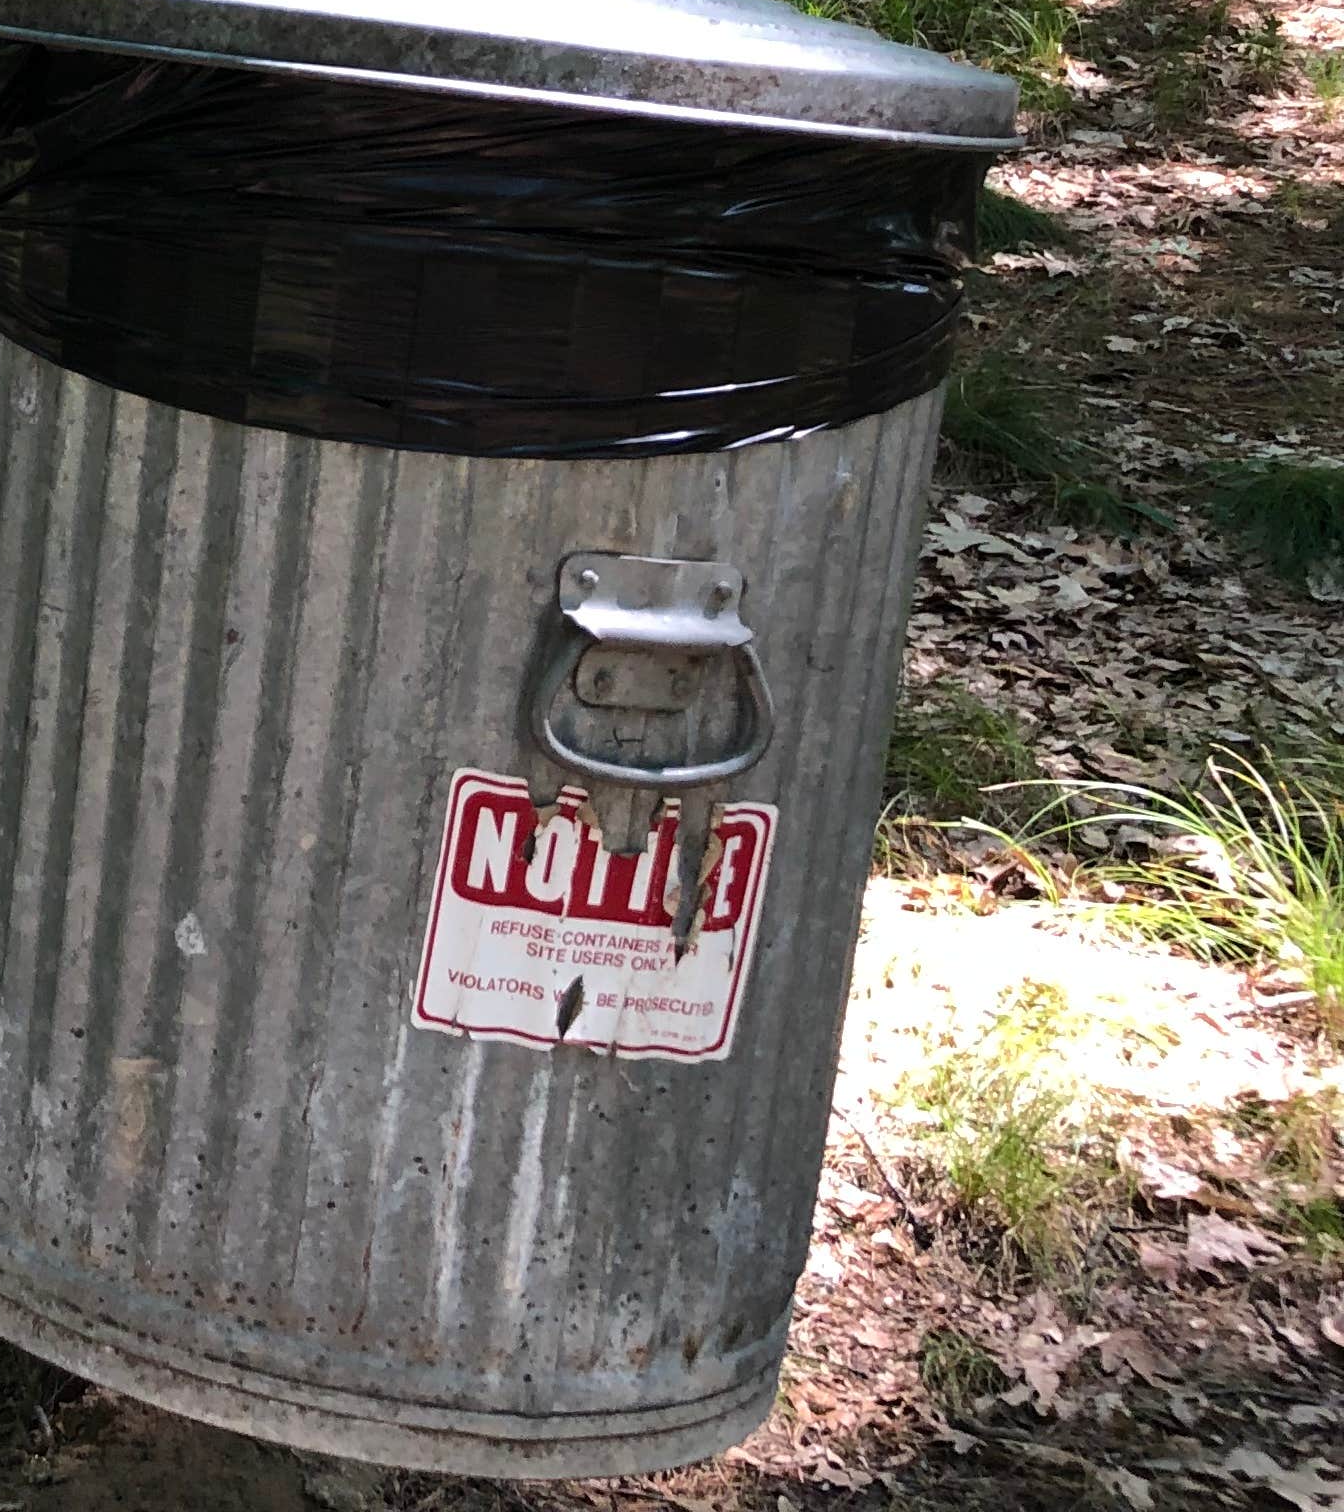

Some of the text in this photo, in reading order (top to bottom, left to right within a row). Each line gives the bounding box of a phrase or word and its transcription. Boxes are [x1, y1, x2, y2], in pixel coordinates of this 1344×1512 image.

[466, 805, 742, 920] NOTIE
[490, 919, 555, 943] REFUSE
[562, 930, 661, 954] CONTAINERS
[526, 941, 567, 963] SITE
[572, 949, 626, 968] USERS
[448, 968, 545, 1000] VIOLATORS
[596, 992, 618, 1007] BE
